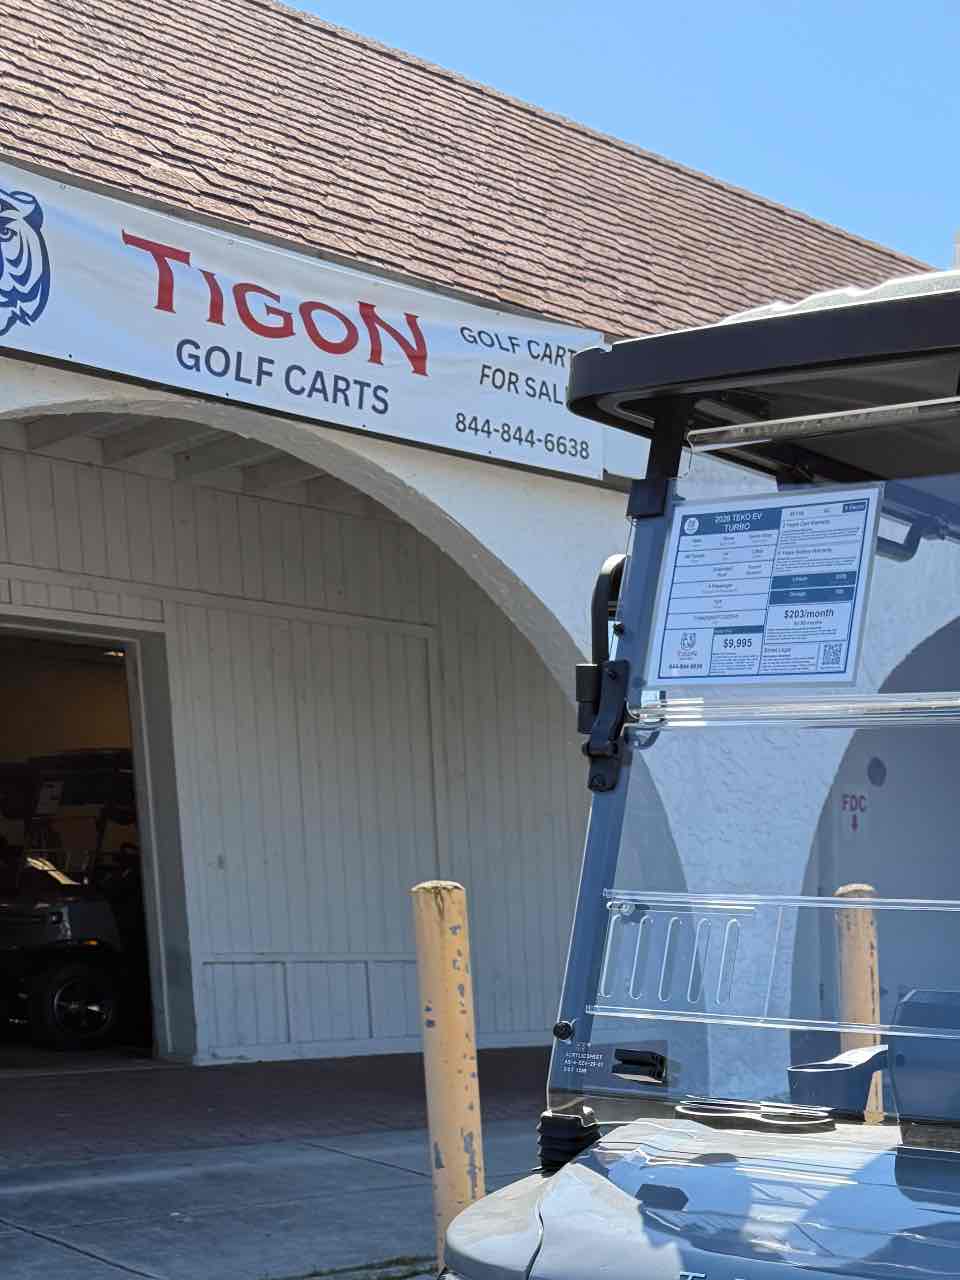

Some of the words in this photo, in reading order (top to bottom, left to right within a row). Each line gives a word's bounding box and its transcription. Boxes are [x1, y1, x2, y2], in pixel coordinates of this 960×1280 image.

[121, 229, 430, 377] TIGON
[460, 326, 520, 354] GOLF
[527, 339, 577, 368] CART
[176, 338, 275, 387] GOLF
[284, 364, 390, 415] CARTS
[480, 364, 519, 394] FOR
[525, 377, 565, 405] SAL
[455, 413, 590, 460] 844-844-6638
[784, 608, 834, 620] $203/month
[723, 638, 753, 649] $9,995
[842, 794, 867, 813] FDC
